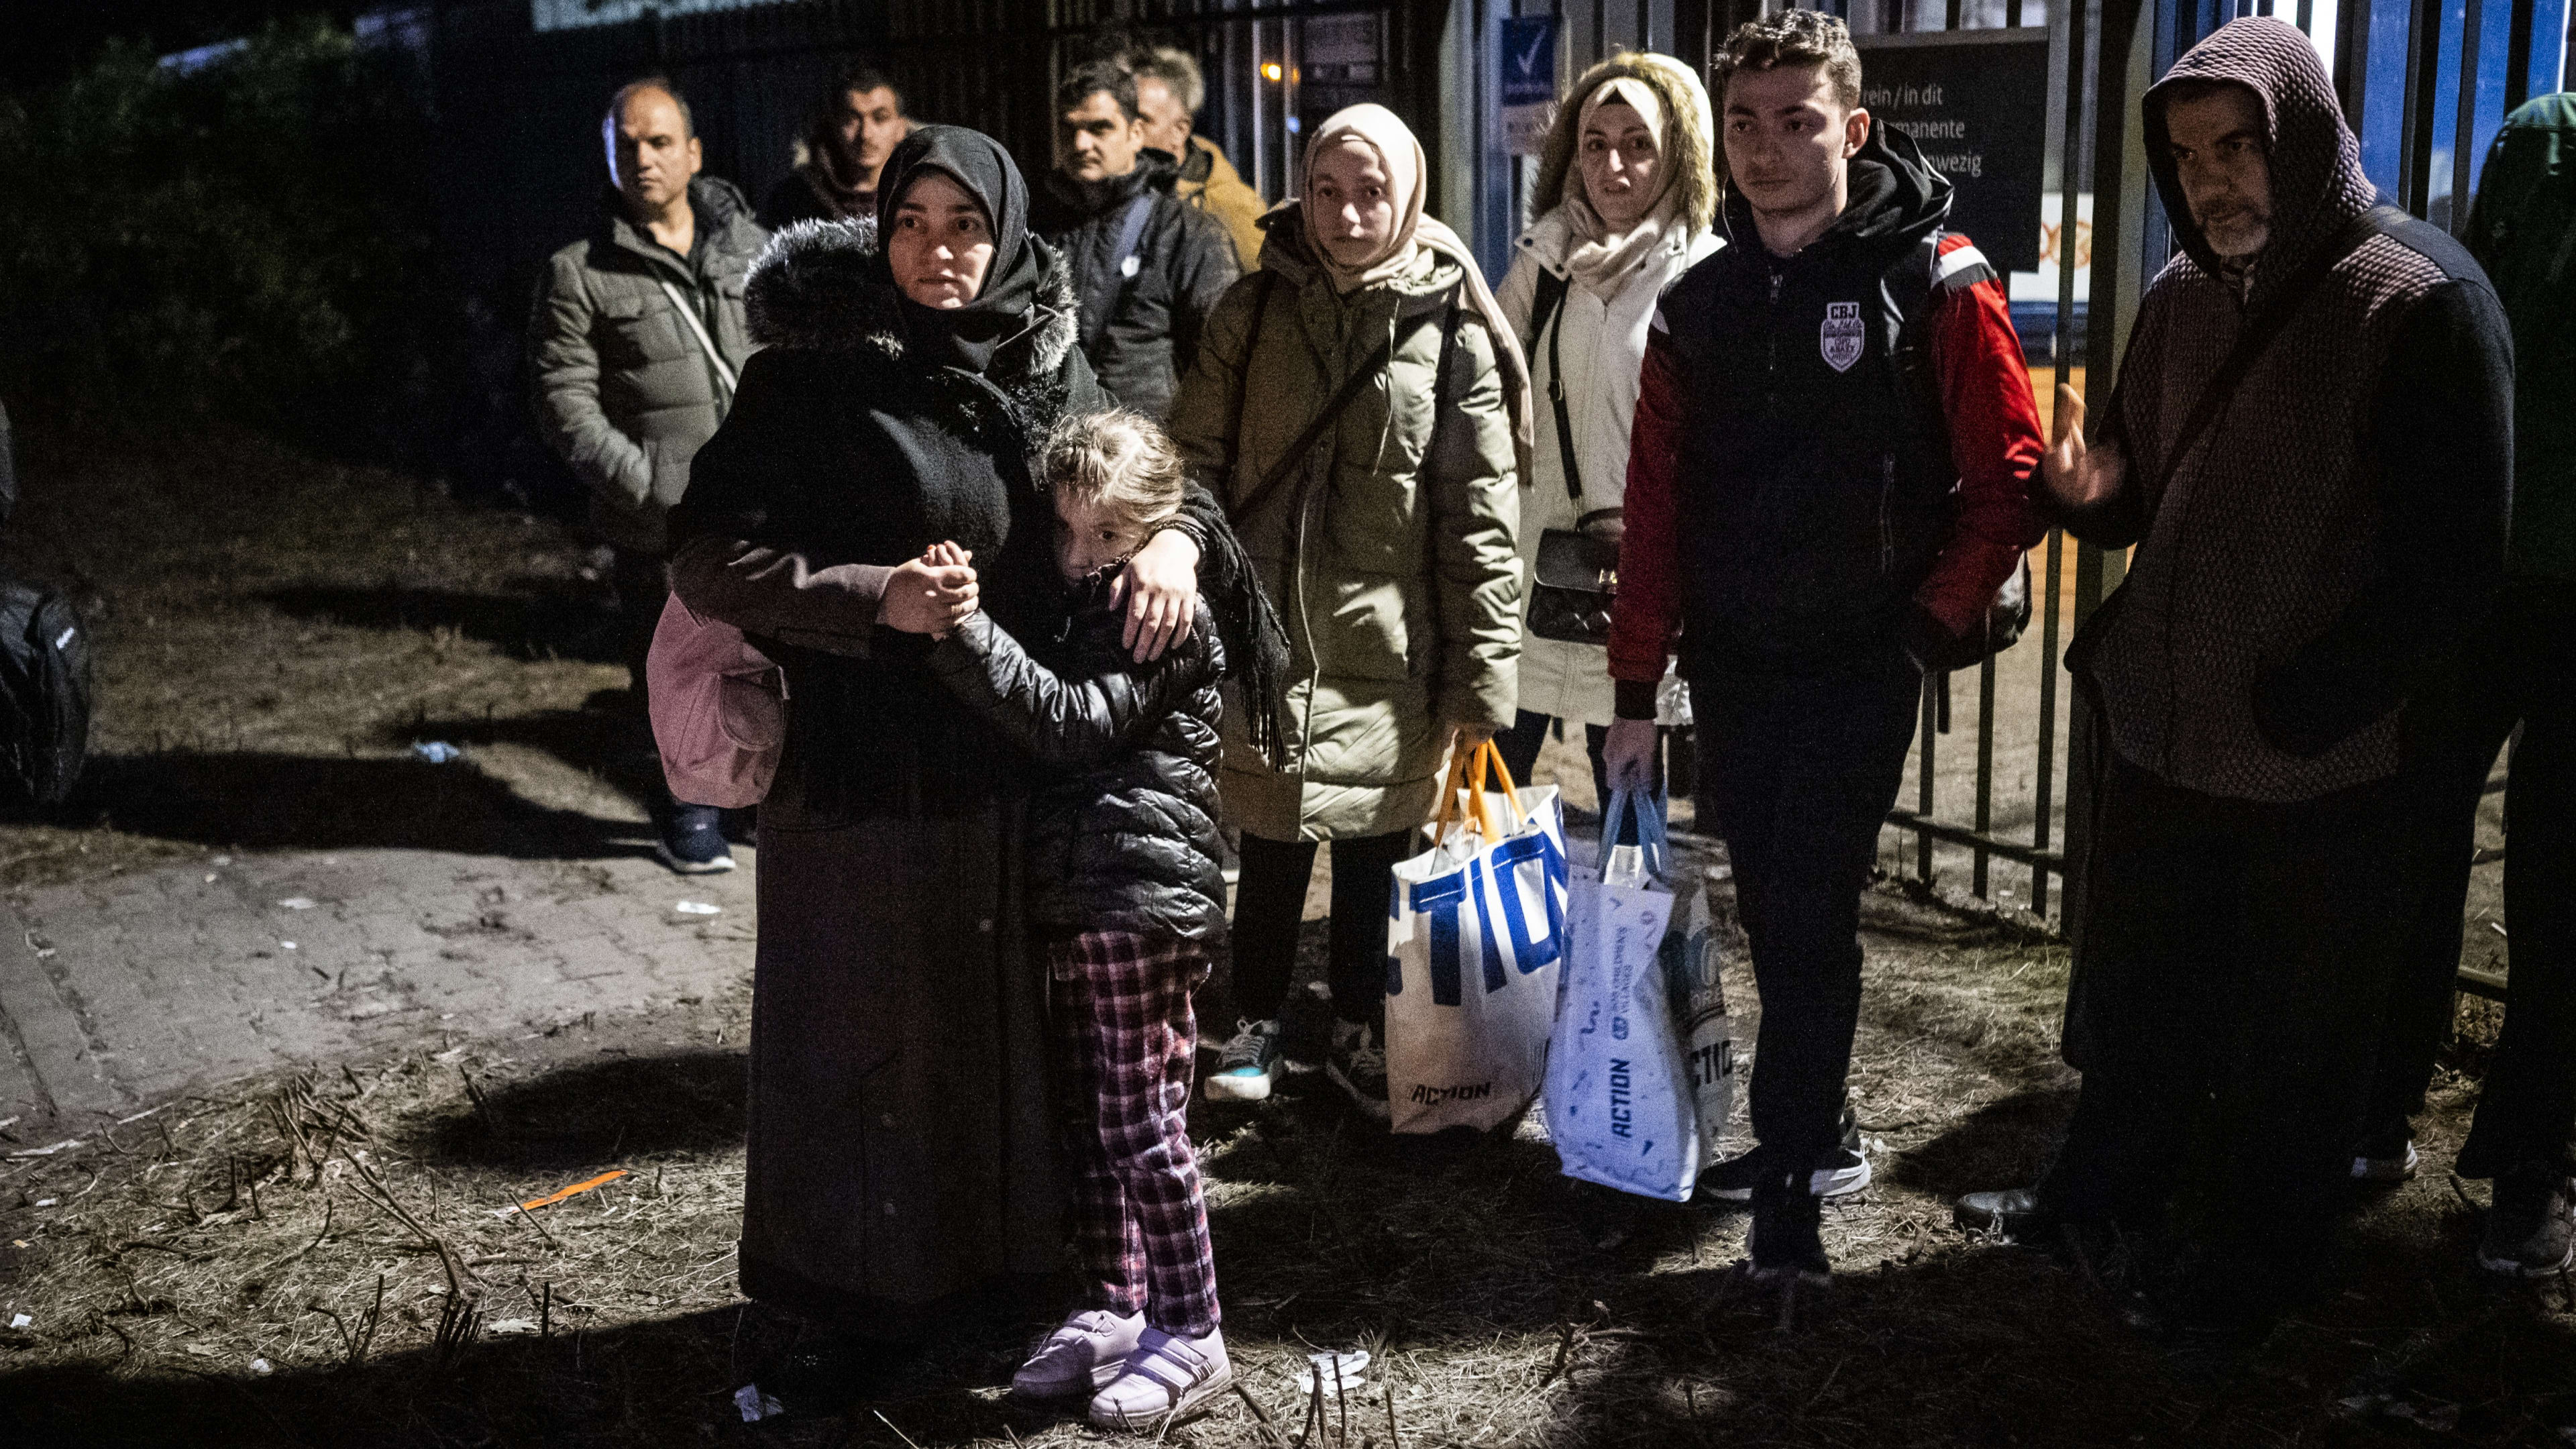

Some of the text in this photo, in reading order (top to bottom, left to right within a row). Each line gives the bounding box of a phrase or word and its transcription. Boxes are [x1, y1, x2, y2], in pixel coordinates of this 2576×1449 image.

[1921, 83, 1943, 105] dit
[1831, 305, 1856, 319] CBJ
[1411, 1081, 1491, 1105] ACTION
[1610, 1059, 1631, 1138] ACTION
